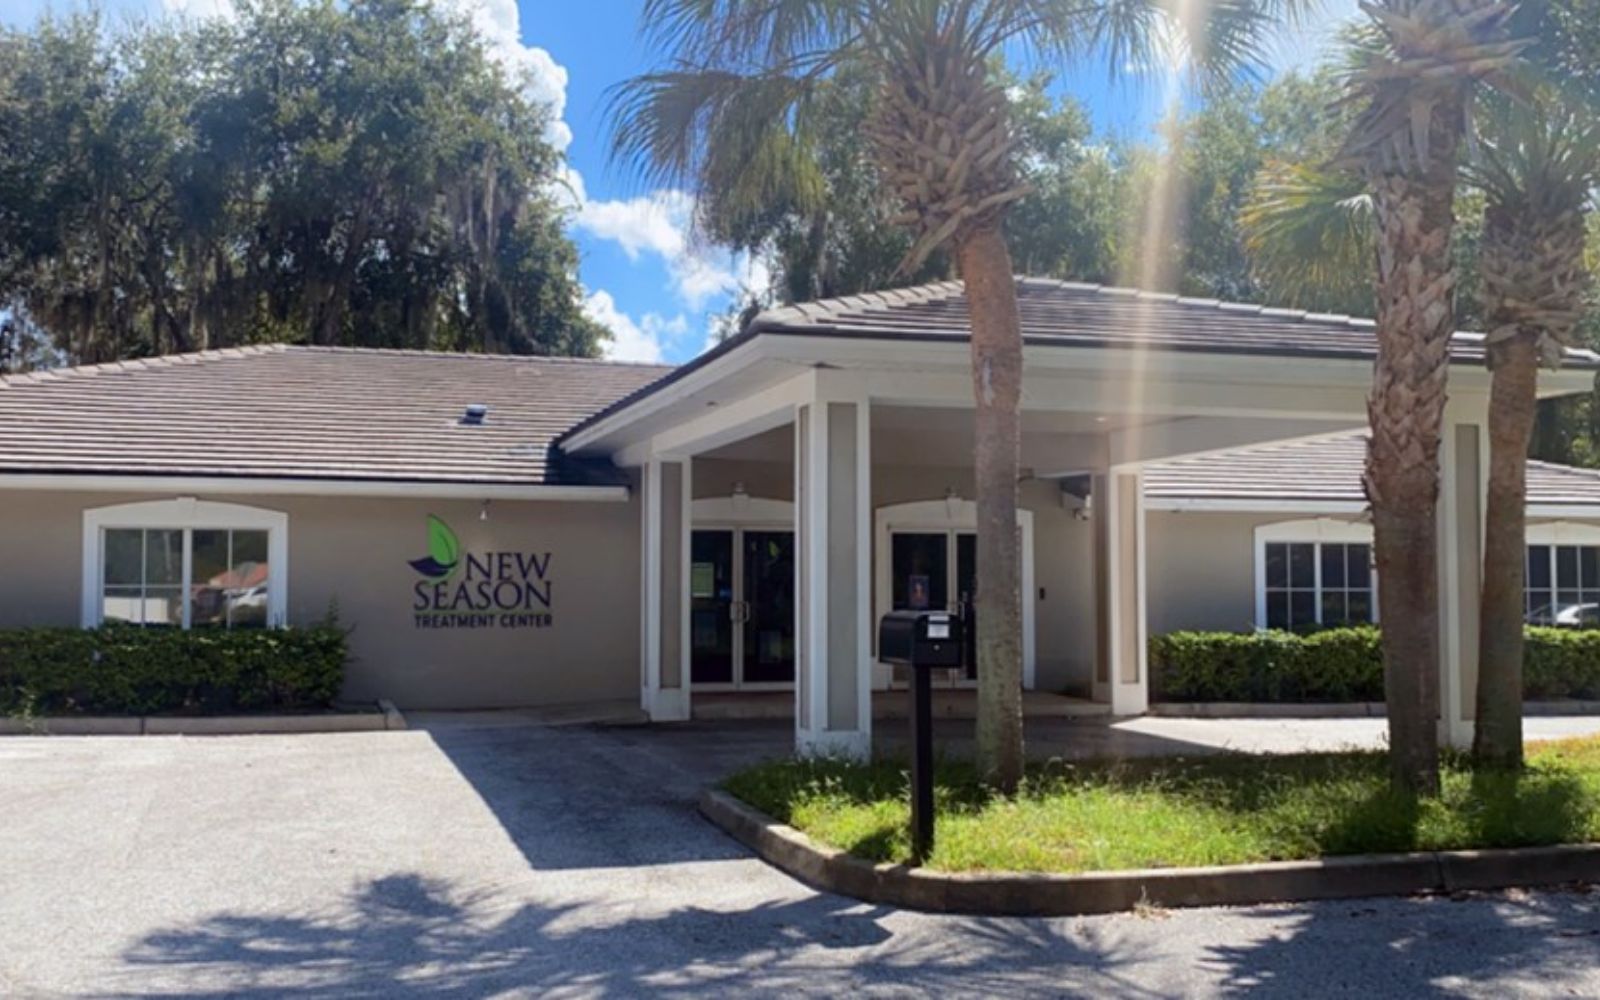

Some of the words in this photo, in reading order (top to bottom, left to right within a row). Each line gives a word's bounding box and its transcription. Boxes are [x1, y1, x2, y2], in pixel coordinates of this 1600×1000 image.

[466, 552, 552, 581] NEW
[413, 580, 552, 611] SEASON
[414, 614, 495, 628] TREATMENT
[500, 613, 552, 628] CENTER
